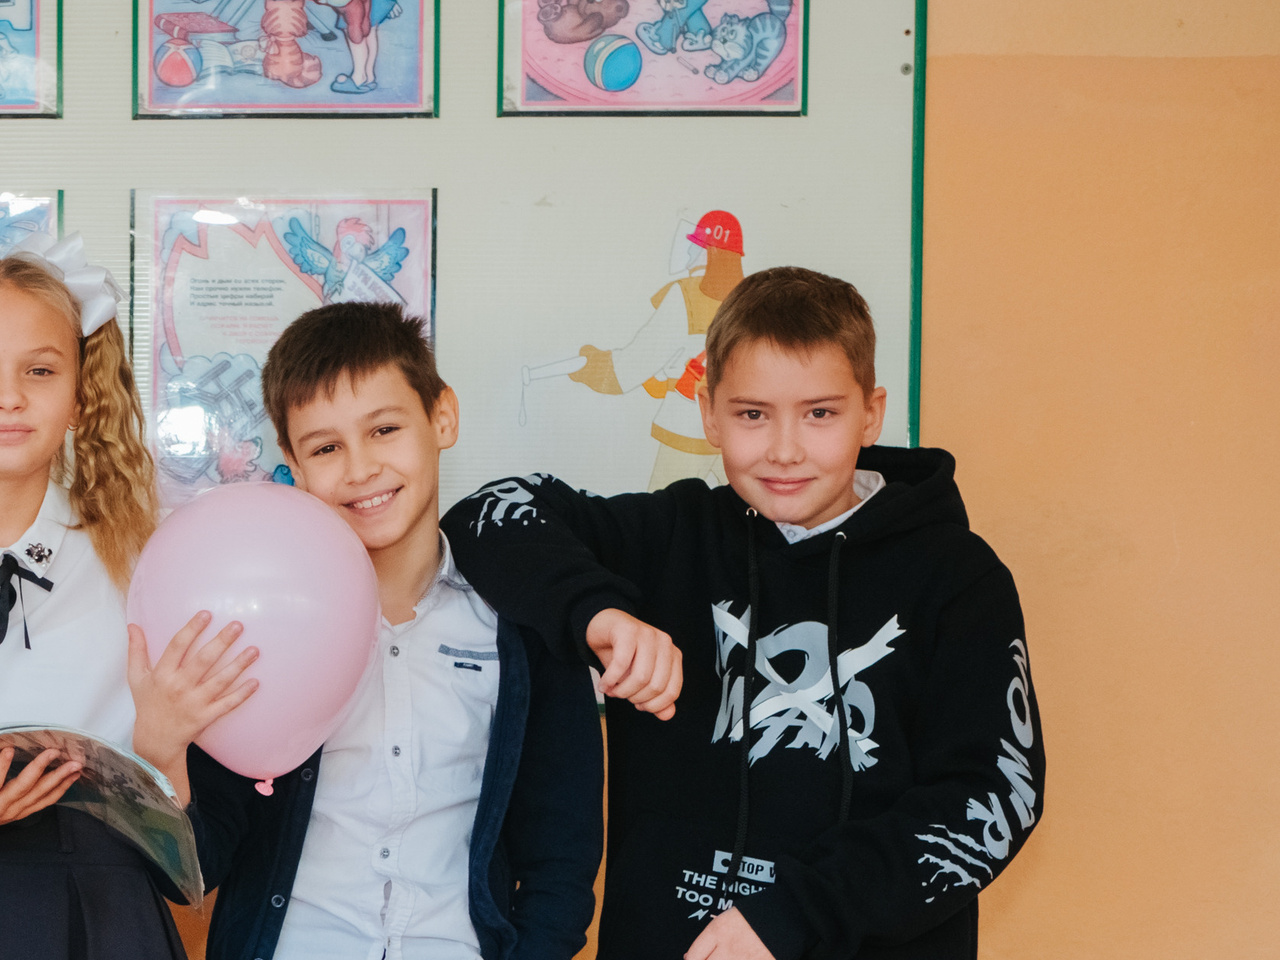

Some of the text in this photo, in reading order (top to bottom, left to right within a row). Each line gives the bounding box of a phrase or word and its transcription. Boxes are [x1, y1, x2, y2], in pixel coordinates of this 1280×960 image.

[713, 225, 730, 243] 01
[682, 868, 719, 890] THE
[675, 885, 714, 907] TOO
